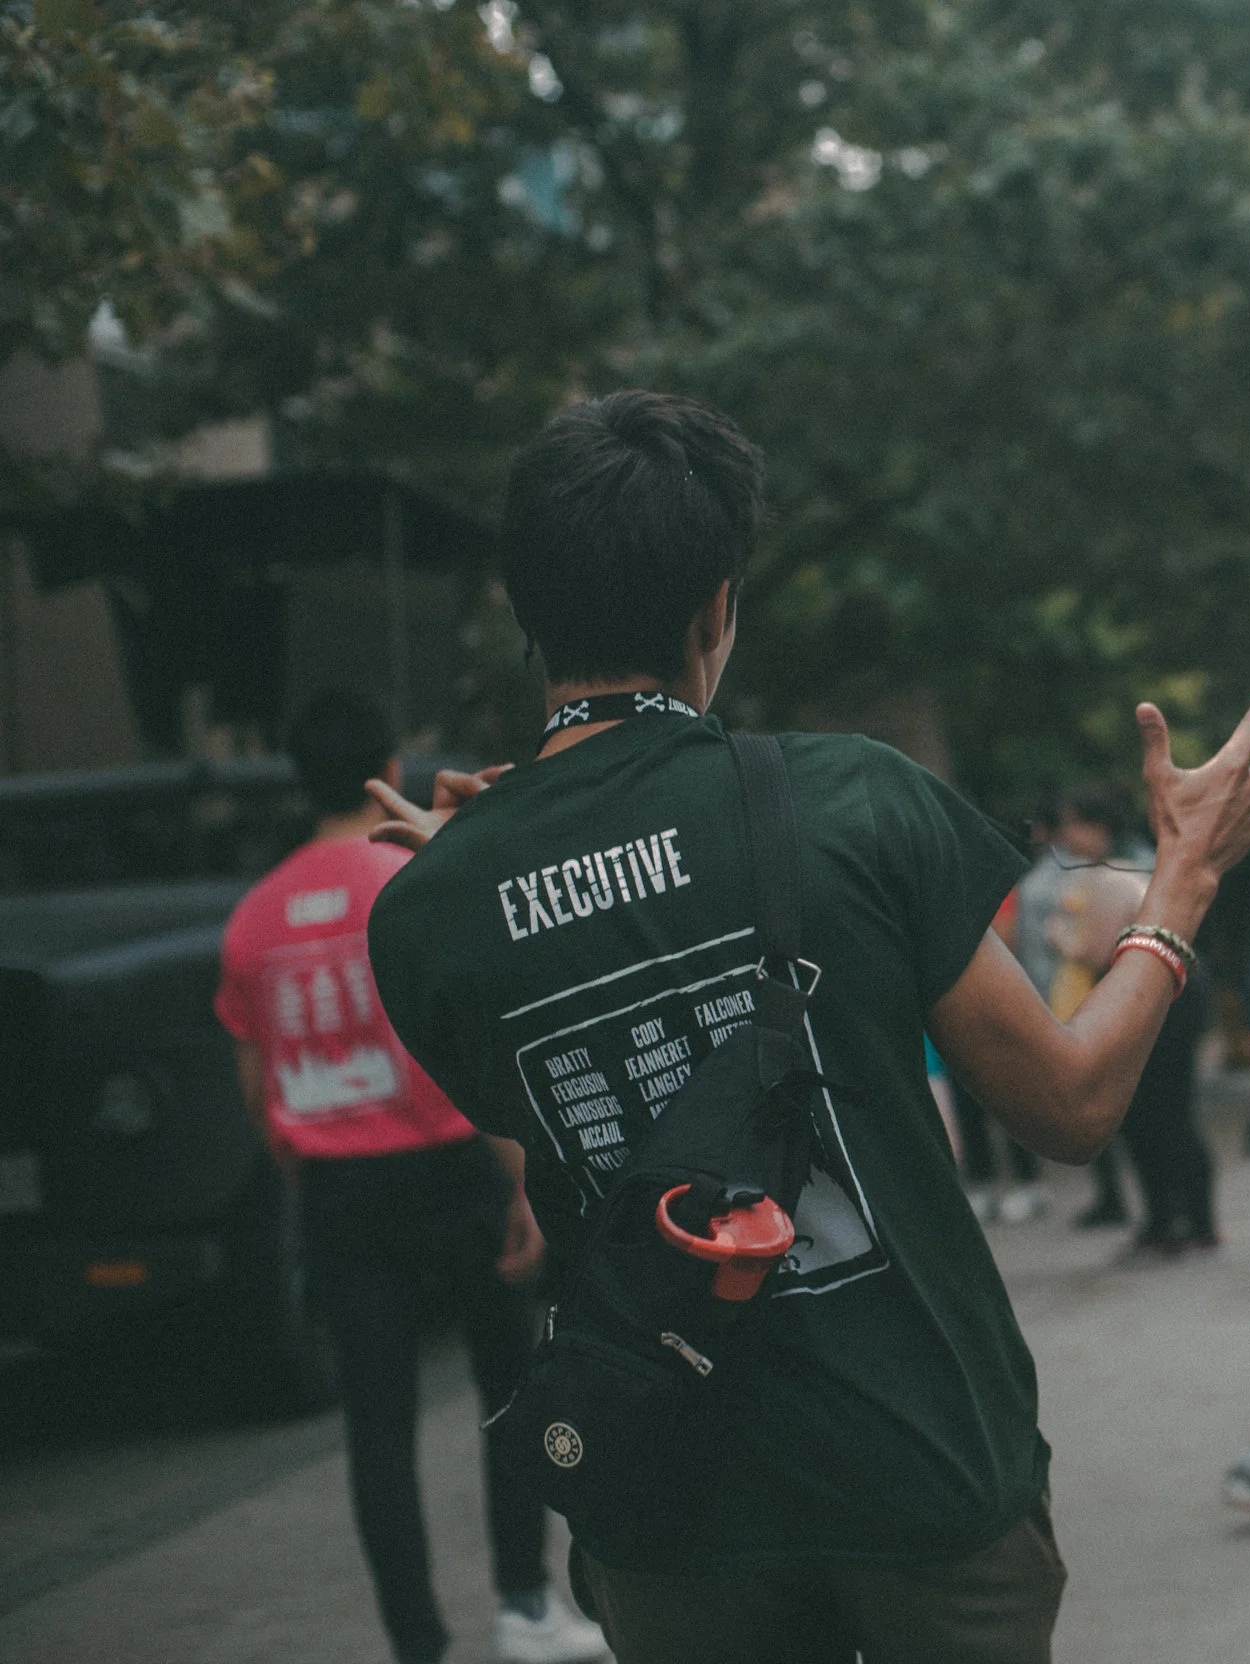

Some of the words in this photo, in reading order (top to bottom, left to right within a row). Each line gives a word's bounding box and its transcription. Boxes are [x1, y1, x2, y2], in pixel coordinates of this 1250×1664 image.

[497, 827, 691, 942] EXECUTIVE
[694, 990, 756, 1028] FALCONER
[630, 1017, 666, 1049] CODY
[709, 1020, 753, 1049] HUT
[545, 1047, 592, 1079] BRATTY
[624, 1036, 693, 1081] JEANNERET
[551, 1071, 610, 1105] FERGUSON
[557, 1095, 624, 1128] LANDSBERG
[578, 1120, 625, 1151] MCCAUL
